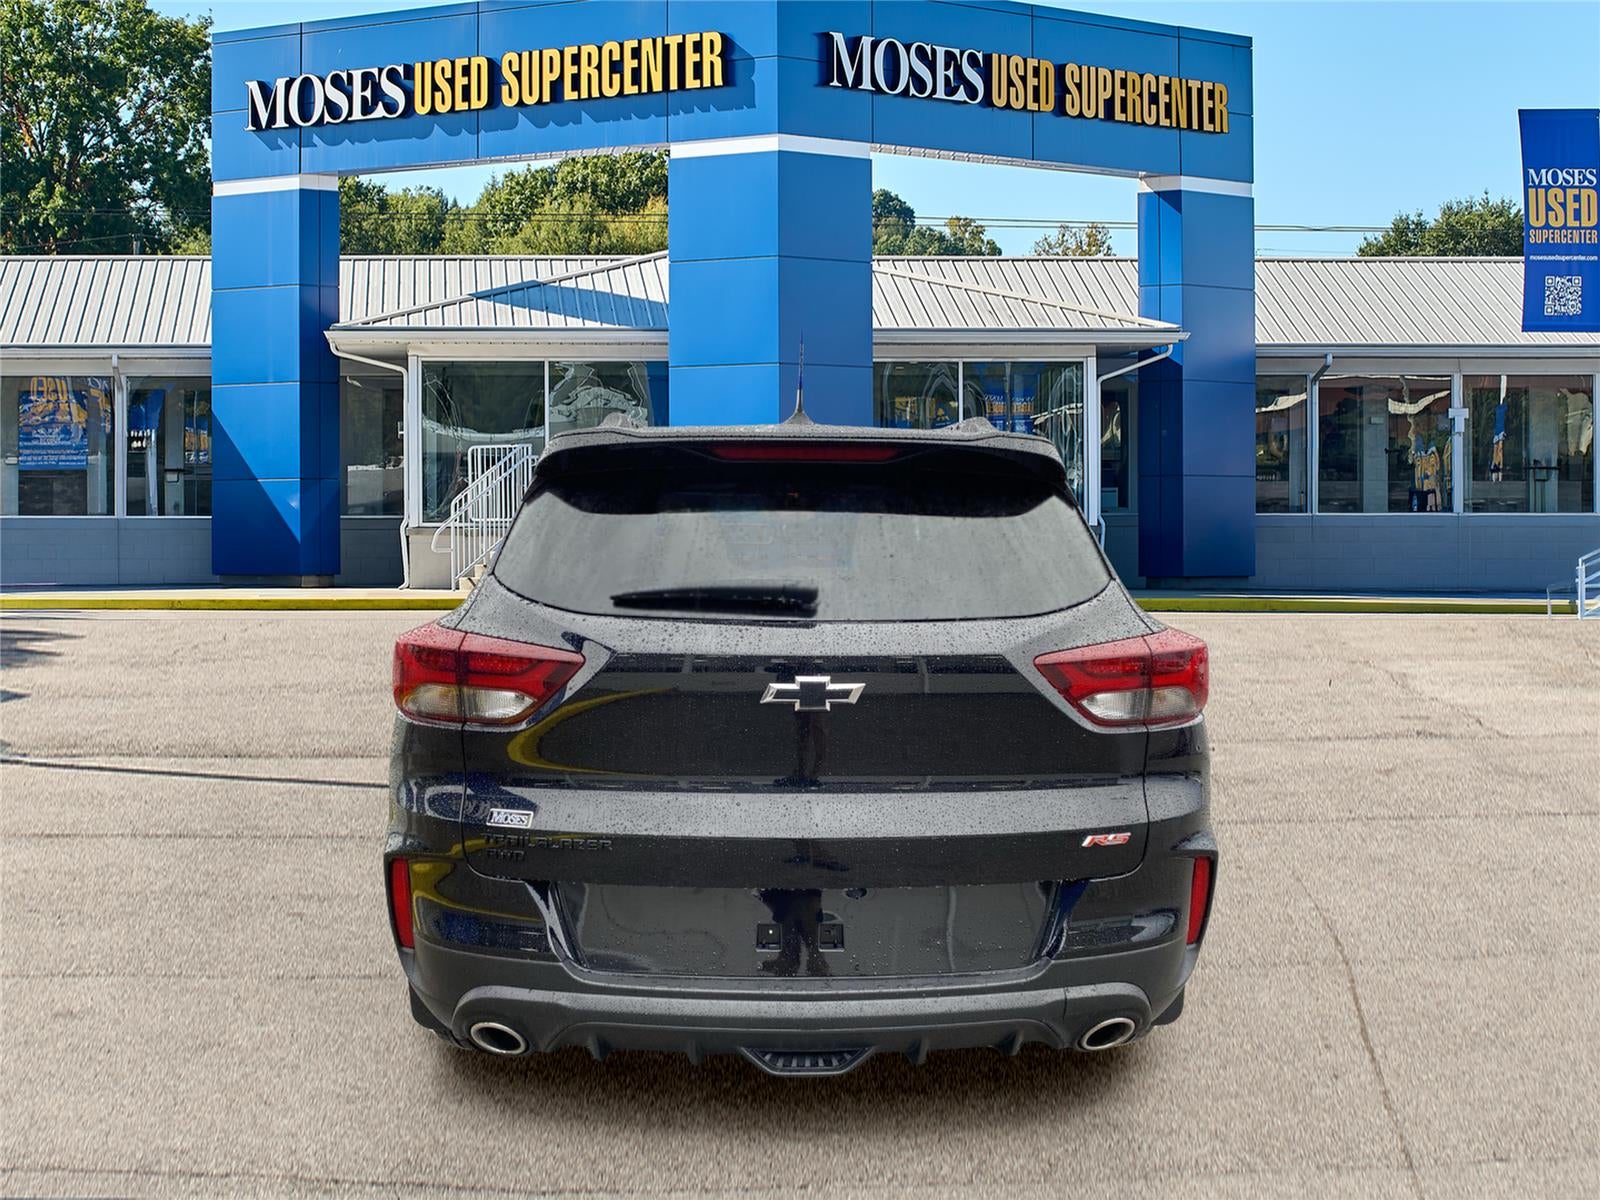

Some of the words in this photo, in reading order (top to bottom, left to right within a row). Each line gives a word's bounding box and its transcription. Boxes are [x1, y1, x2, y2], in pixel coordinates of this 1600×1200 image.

[245, 64, 406, 132] MOSES
[413, 55, 489, 116] USED
[501, 31, 725, 107] SUPERCENTER
[828, 31, 985, 105] MOSES
[991, 52, 1055, 113] USED
[1064, 62, 1230, 134] SUPERCENTER
[1527, 168, 1598, 187] MOSES
[1528, 187, 1598, 228] USED
[1529, 229, 1598, 244] SUPERCENTER
[490, 809, 529, 826] MOSES
[1081, 831, 1132, 848] RS
